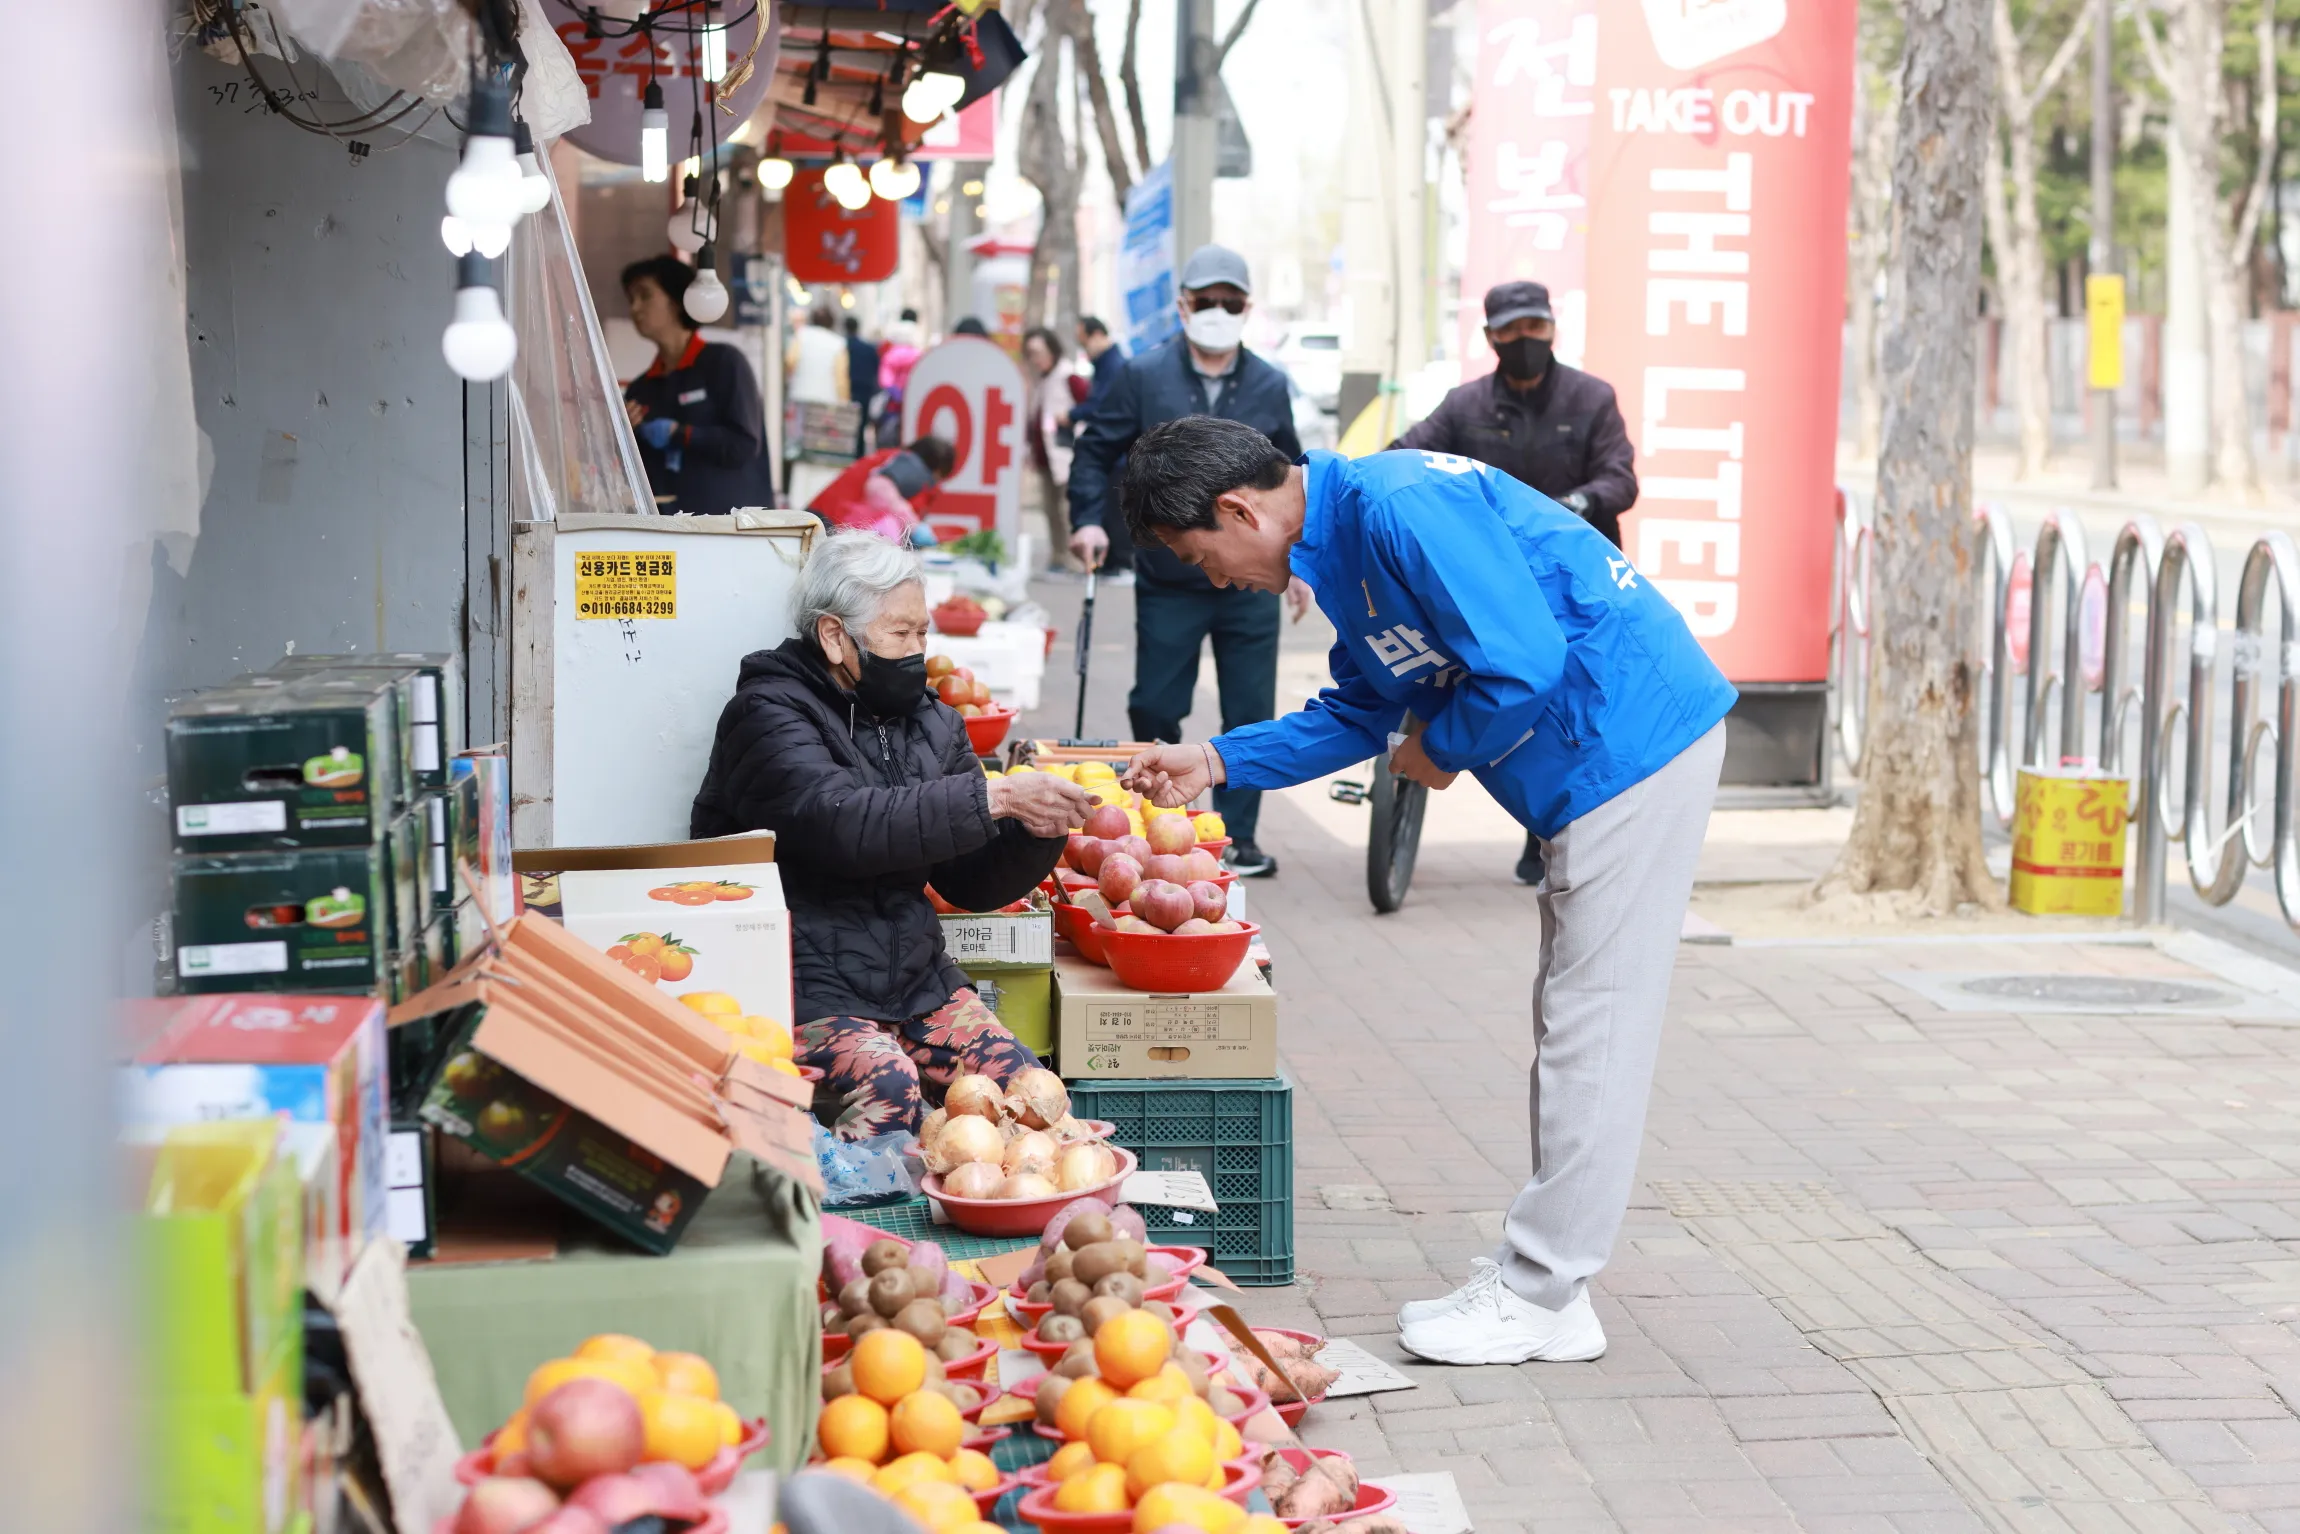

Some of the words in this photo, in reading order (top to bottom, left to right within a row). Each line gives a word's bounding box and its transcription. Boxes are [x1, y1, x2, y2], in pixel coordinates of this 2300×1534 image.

[1608, 87, 1714, 133] TAKE
[1722, 89, 1816, 137] OUT
[1646, 152, 1752, 336] THE
[580, 561, 631, 576] 신용카드
[635, 561, 673, 576] 현금화
[1361, 578, 1378, 618] 1
[955, 927, 993, 941] 가야금
[960, 943, 987, 953] 토마토
